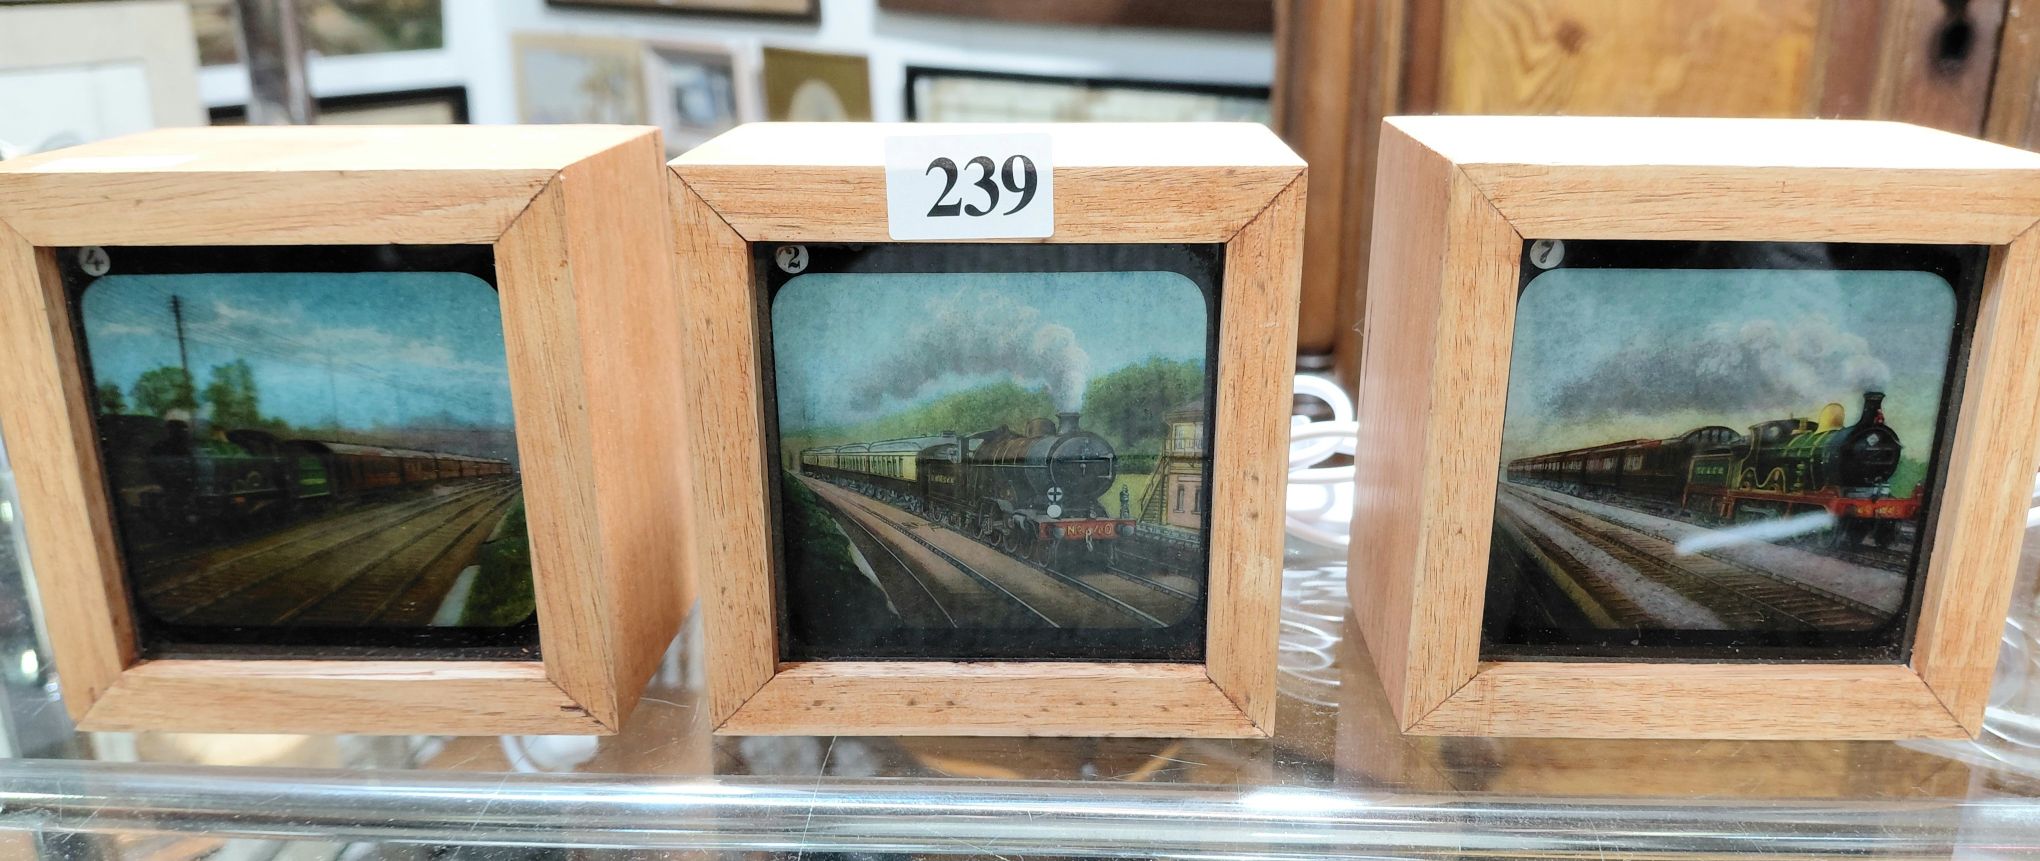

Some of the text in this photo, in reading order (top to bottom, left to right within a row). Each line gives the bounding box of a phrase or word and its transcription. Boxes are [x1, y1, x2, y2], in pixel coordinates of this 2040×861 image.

[925, 154, 1038, 217] 239
[85, 249, 105, 271] 4
[785, 246, 801, 269] 2
[1540, 241, 1555, 264] 7
